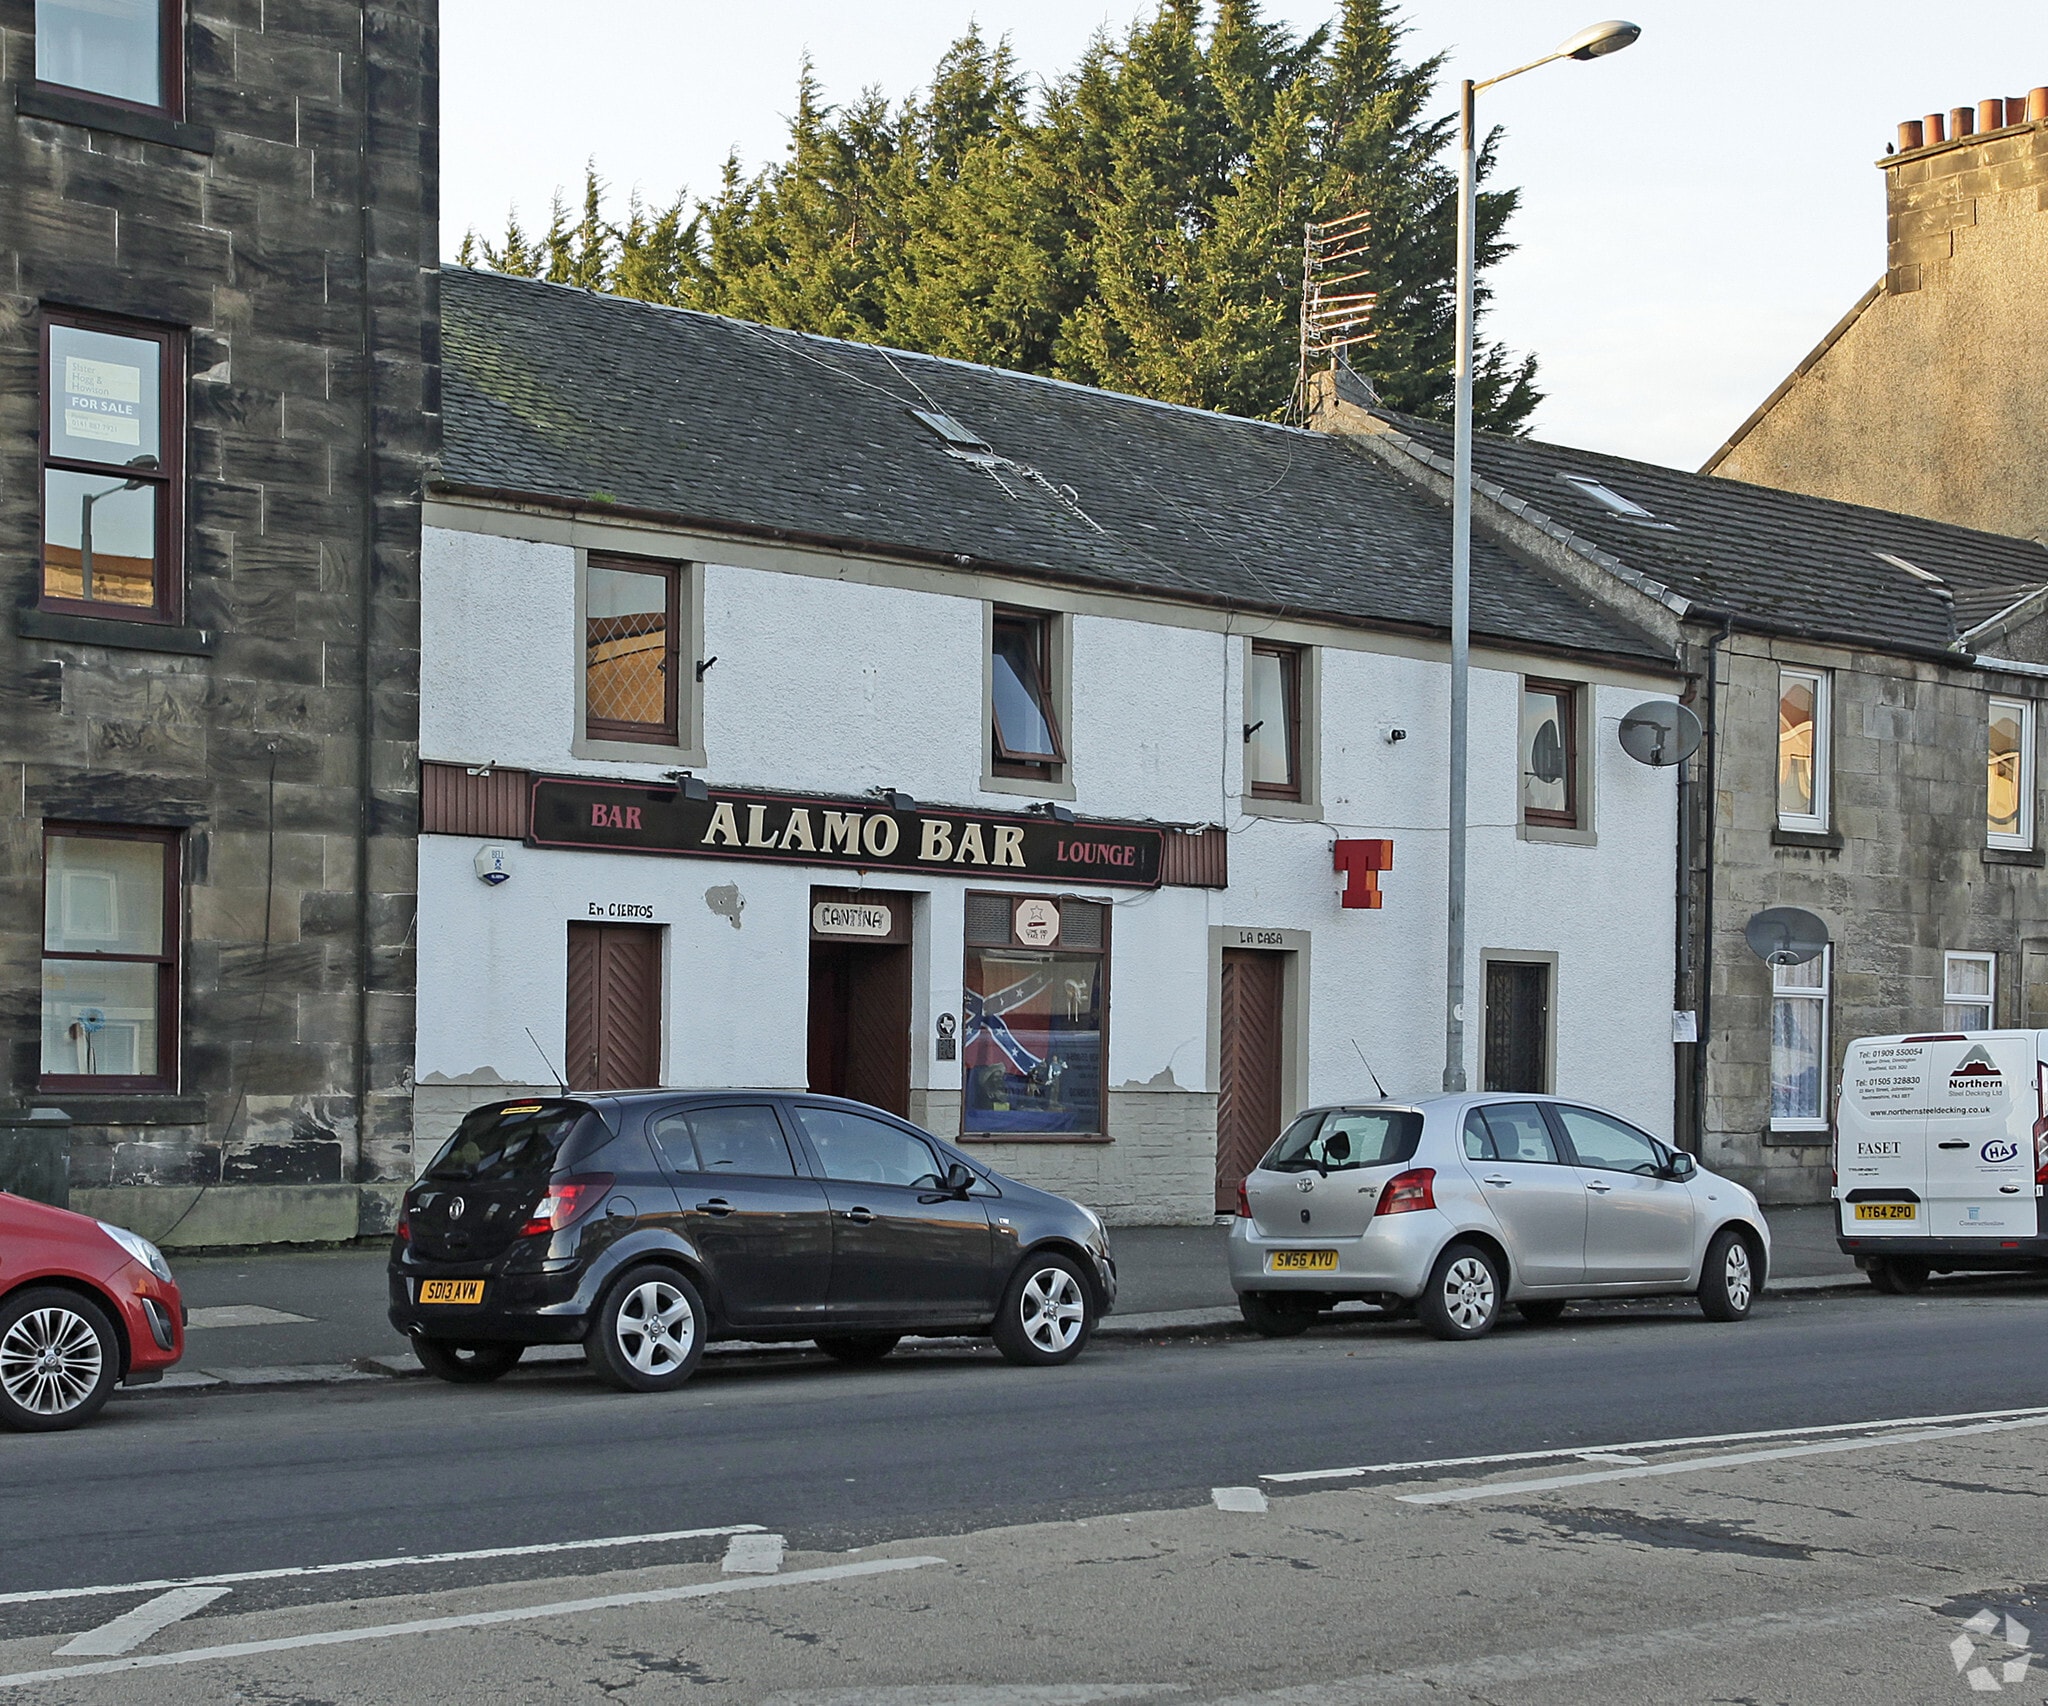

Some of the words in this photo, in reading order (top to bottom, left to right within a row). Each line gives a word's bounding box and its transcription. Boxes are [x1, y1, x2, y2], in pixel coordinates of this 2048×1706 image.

[72, 372, 95, 386] Hogg
[72, 382, 110, 396] Howison
[72, 396, 98, 410] FOR
[101, 401, 133, 415] SALE
[591, 803, 642, 830] BAR
[701, 801, 900, 858] ALAMO
[917, 818, 1027, 868] BAR
[1057, 840, 1136, 867] LOUNGE
[588, 902, 604, 916] En
[608, 902, 653, 919] CIERTOS
[821, 904, 884, 929] CANTINA
[1240, 931, 1254, 944] LA
[1257, 932, 1283, 945] CASA
[1859, 1051, 1871, 1059] Tel:
[1872, 1049, 1895, 1058] 01909
[1896, 1048, 1923, 1057] 550054
[1855, 1079, 1868, 1087] Tel:
[1869, 1077, 1891, 1086] 01505
[1892, 1076, 1921, 1085] 328830
[1949, 1079, 2003, 1089] Northern
[1965, 1090, 1991, 1098] Decking
[1869, 1106, 1991, 1116] www.northernsteeldecking.co.uk
[1857, 1141, 1902, 1155] FASET
[1980, 1139, 2018, 1163] CHAS
[1860, 1206, 1887, 1218] YT64
[1309, 1252, 1333, 1267] AYU
[428, 1282, 453, 1299] SD13
